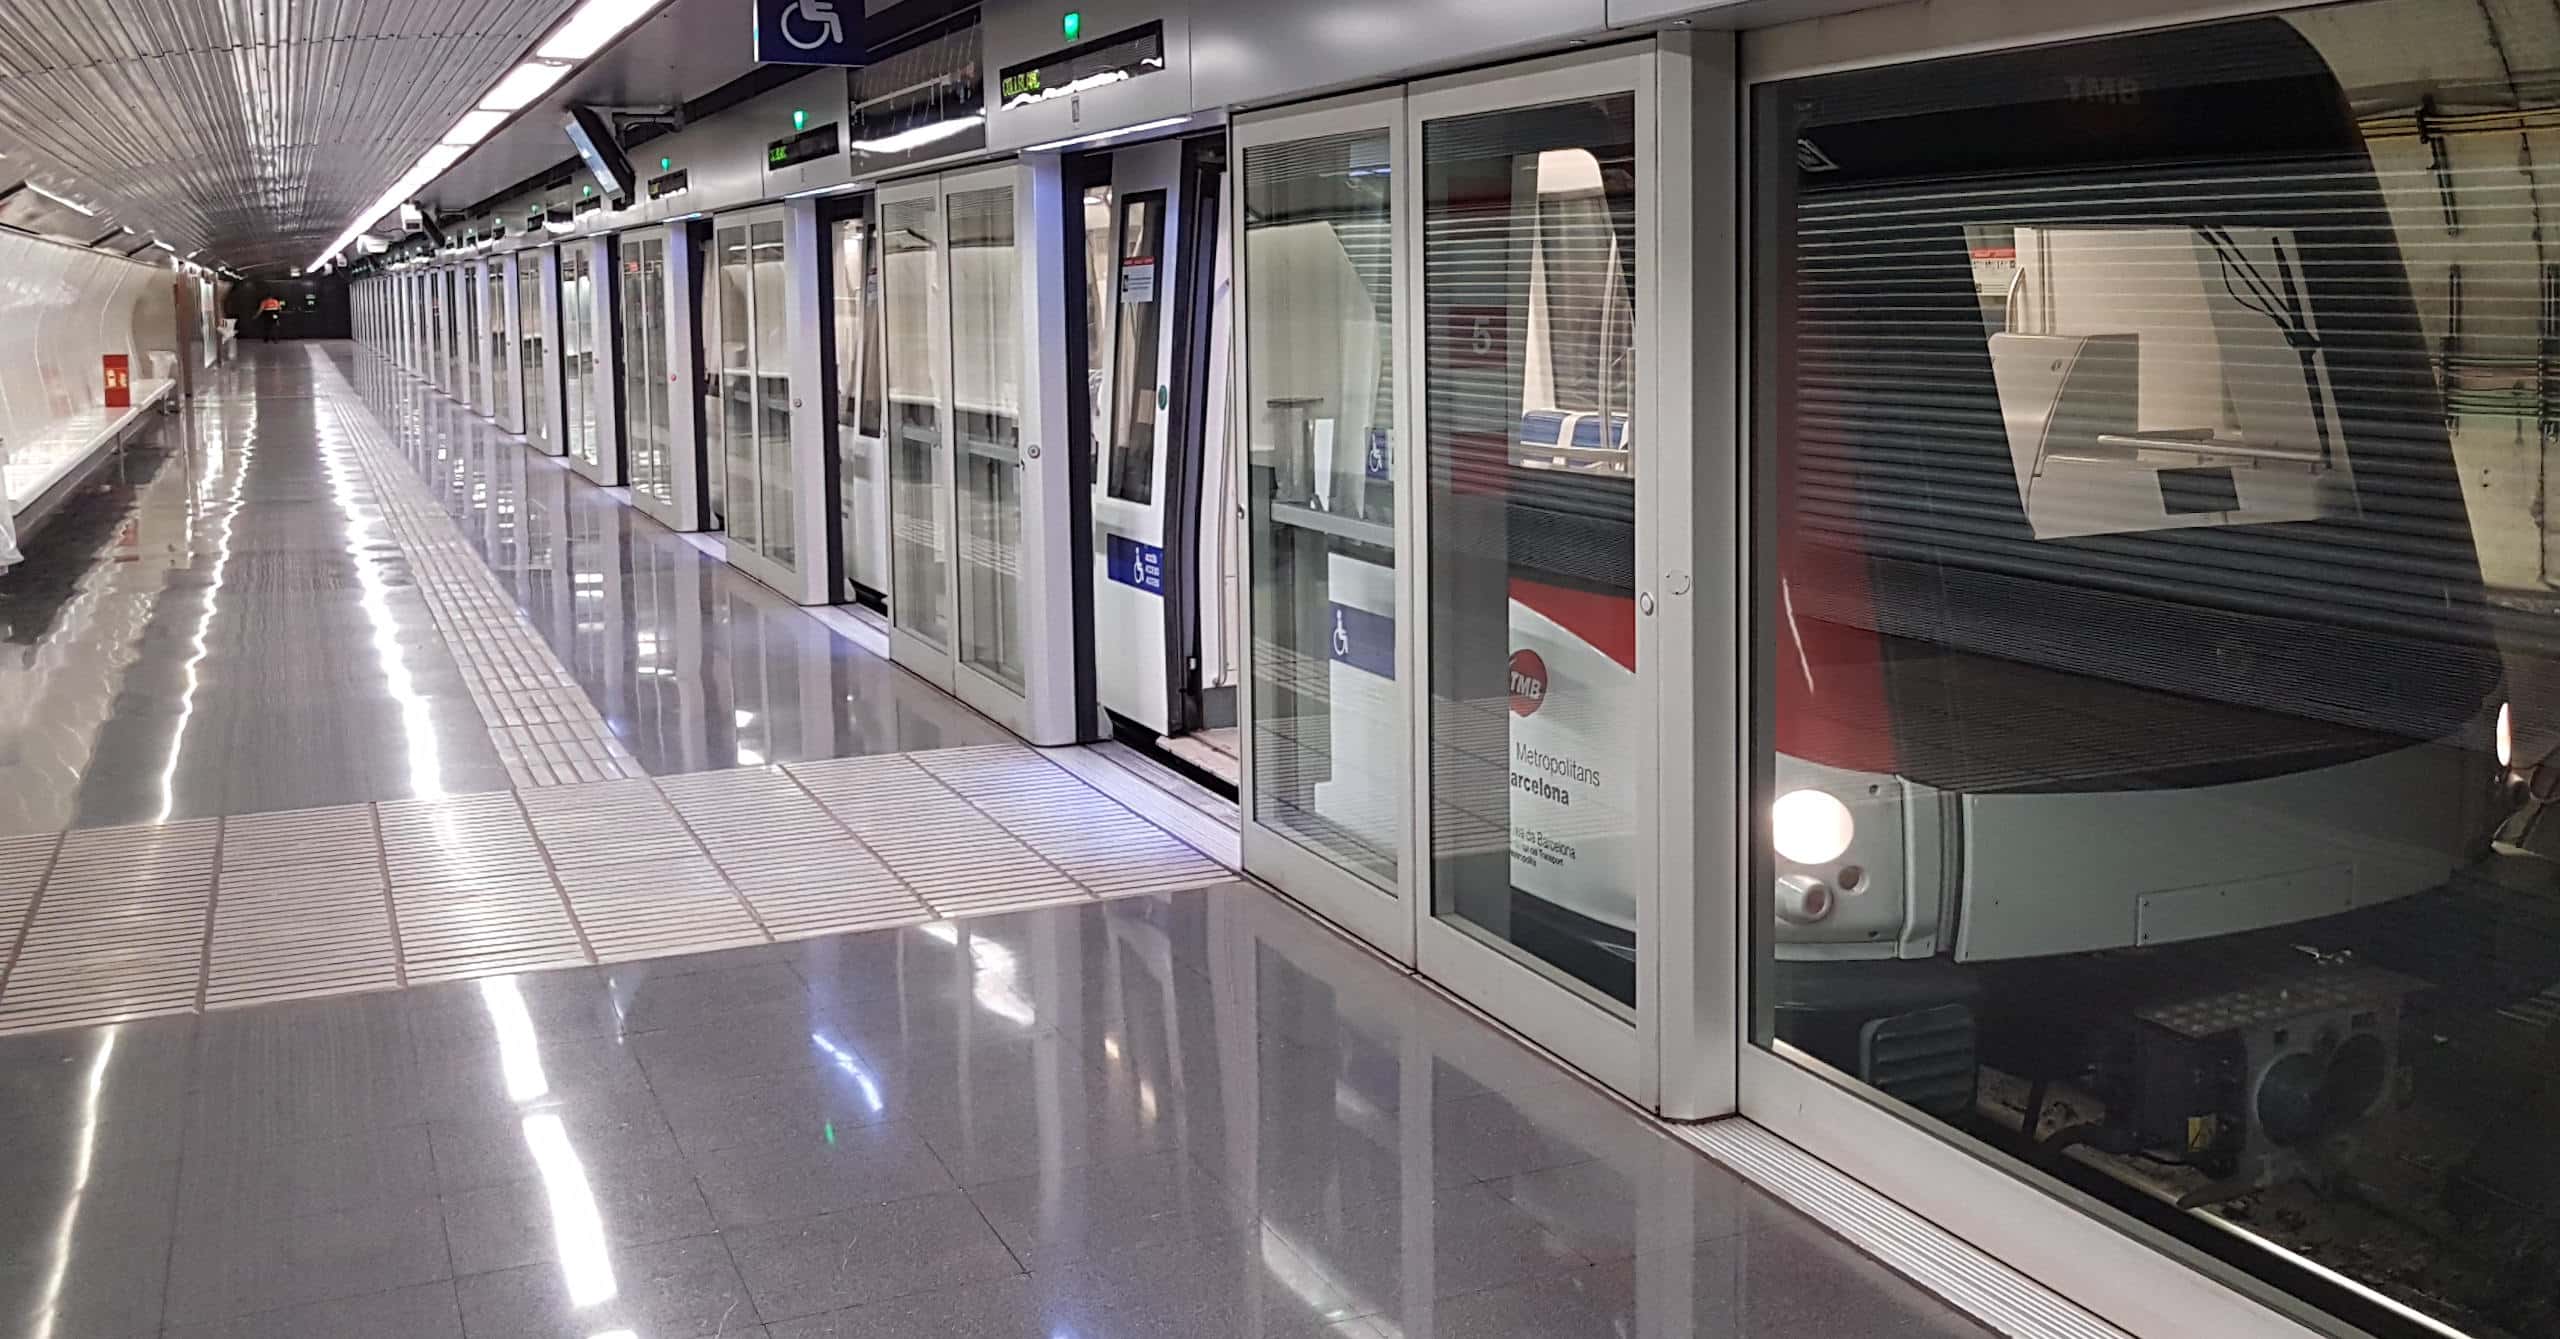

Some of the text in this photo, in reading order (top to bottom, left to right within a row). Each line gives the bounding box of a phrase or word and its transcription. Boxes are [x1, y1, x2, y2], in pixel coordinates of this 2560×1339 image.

[1472, 318, 1491, 354] 5
[1510, 671, 1541, 699] TMB
[1516, 742, 1600, 787] Metropolitans
[1511, 772, 1569, 806] arcelona
[1537, 832, 1576, 860] Barcelona
